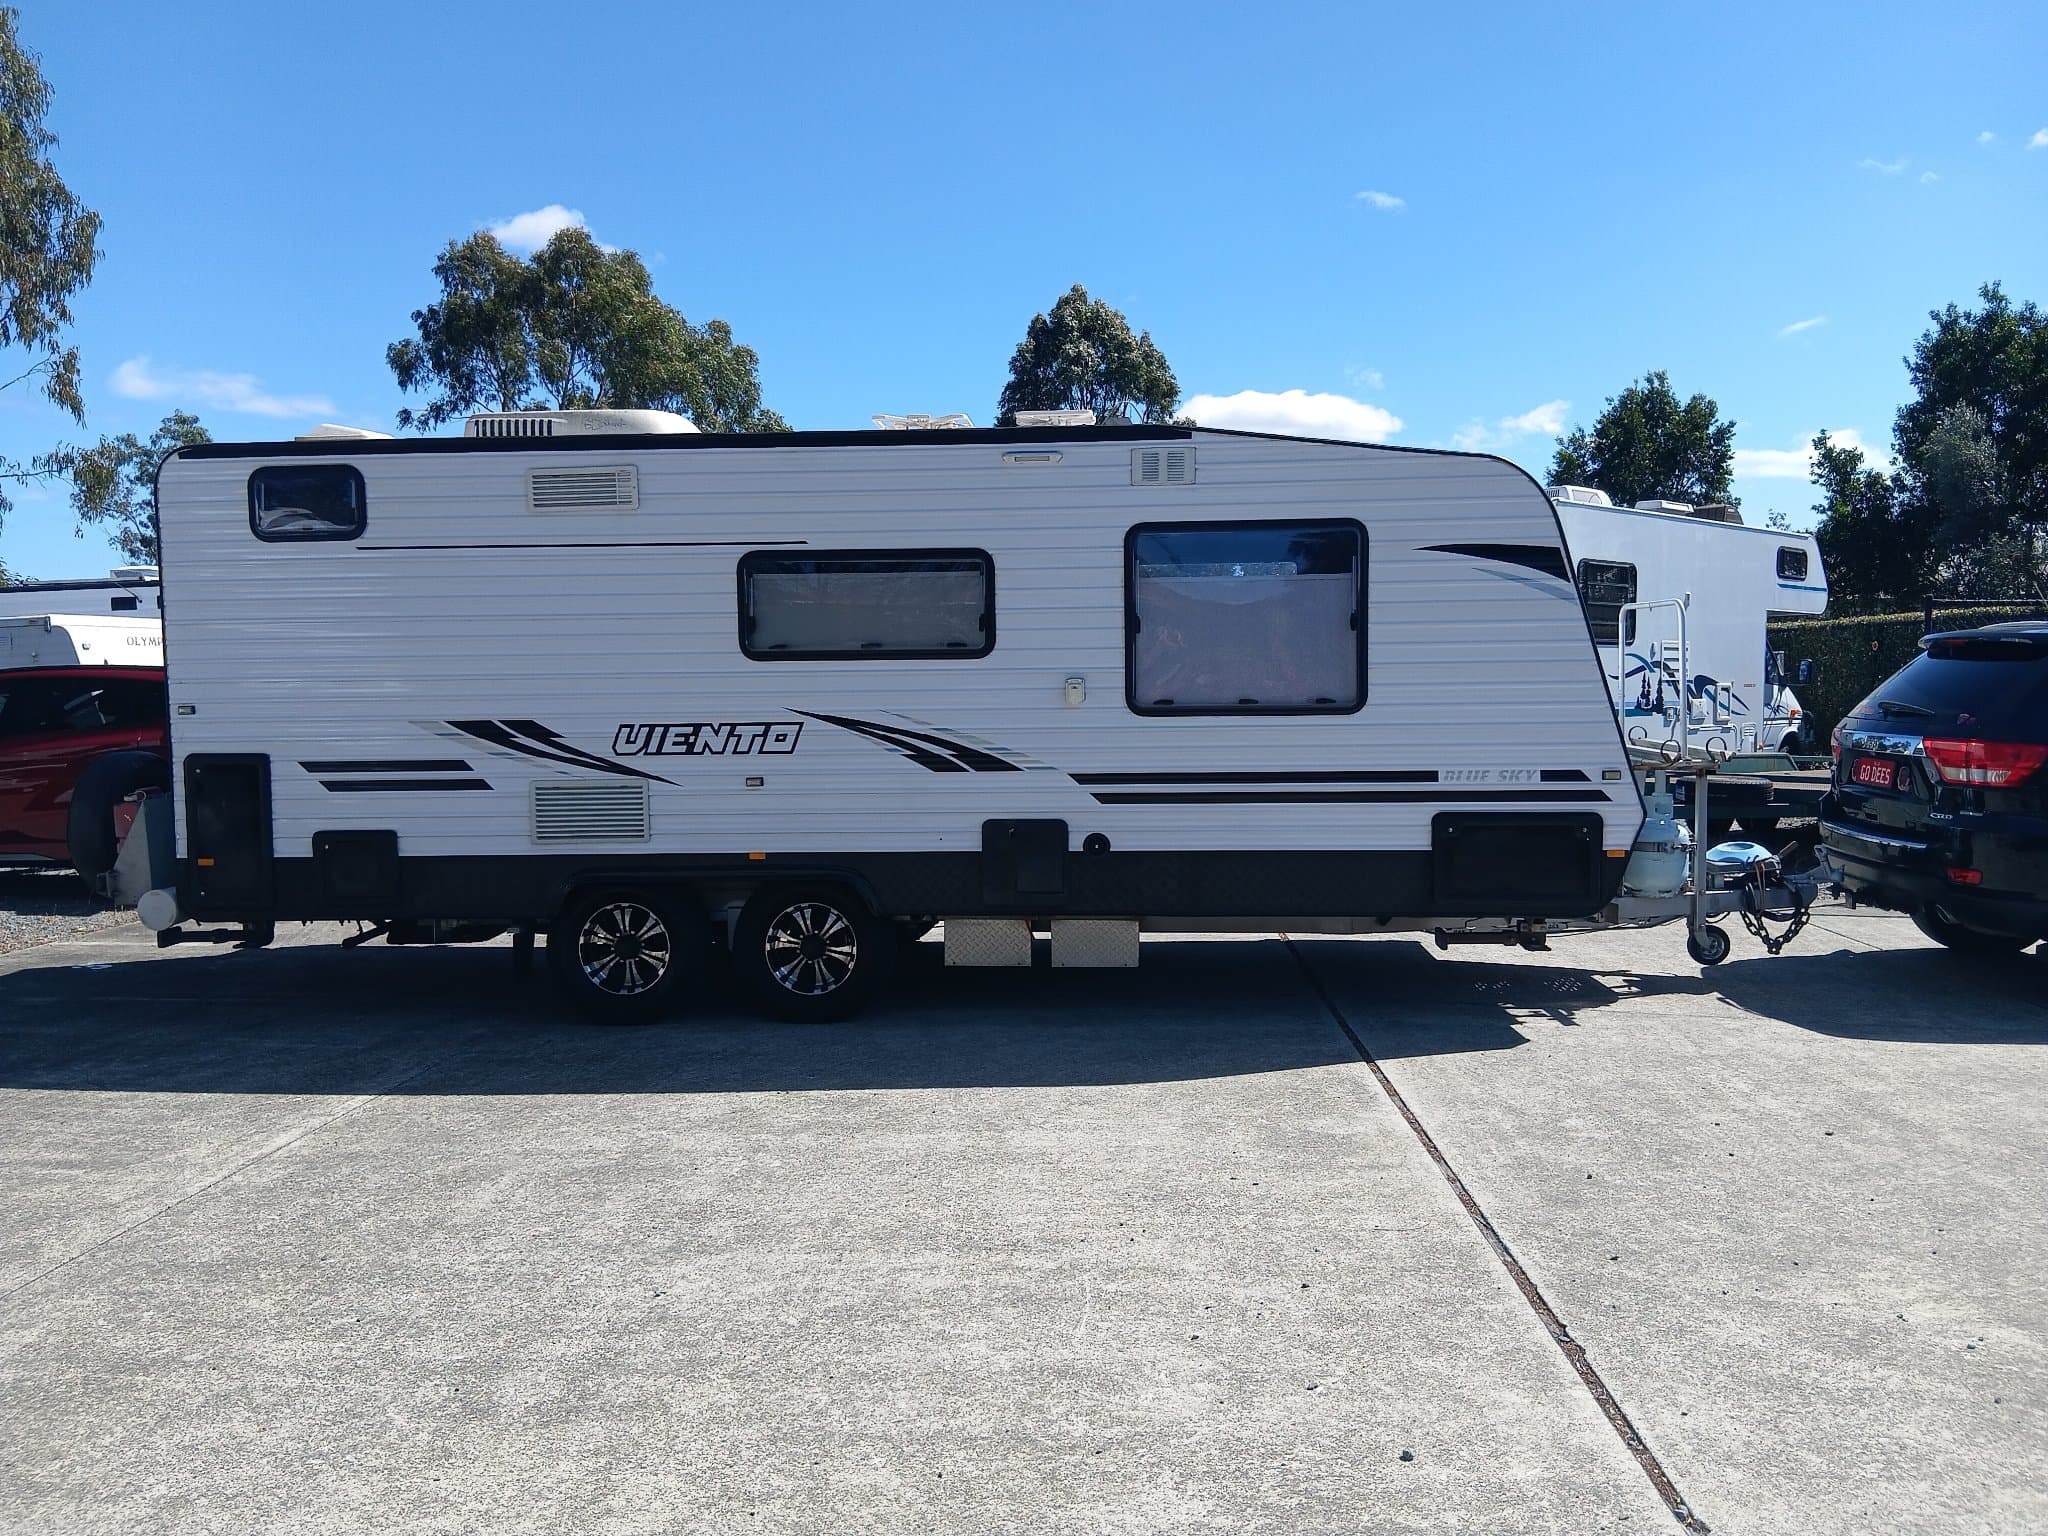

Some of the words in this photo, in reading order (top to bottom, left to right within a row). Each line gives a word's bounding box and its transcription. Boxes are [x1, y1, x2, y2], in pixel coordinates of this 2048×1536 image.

[1443, 768, 1490, 783] BLUE
[1496, 768, 1538, 783] SKY
[1860, 764, 1871, 781] GO
[1871, 766, 1891, 785] DEES
